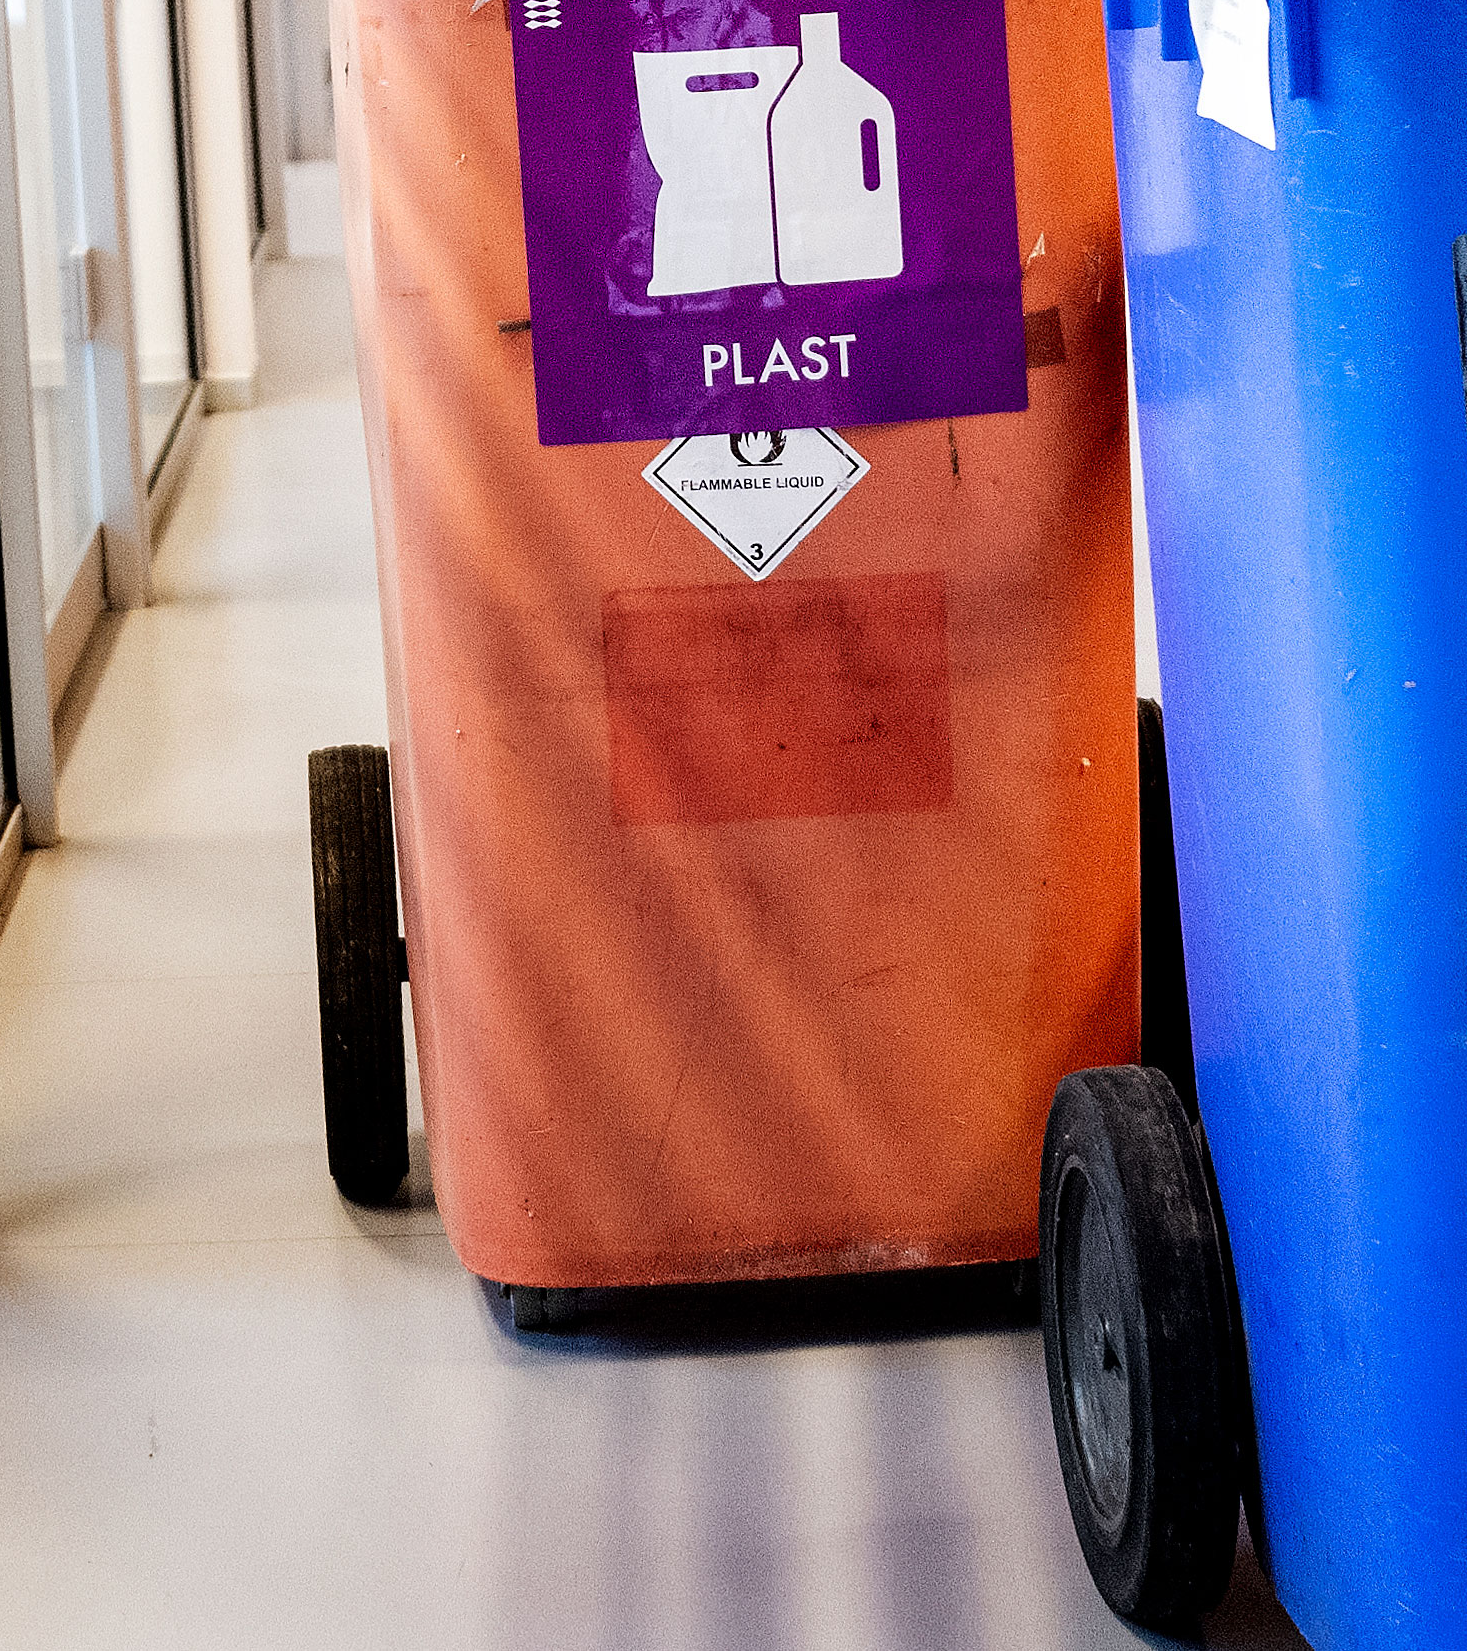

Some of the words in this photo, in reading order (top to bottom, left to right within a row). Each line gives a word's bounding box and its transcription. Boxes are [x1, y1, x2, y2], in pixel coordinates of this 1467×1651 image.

[703, 334, 857, 387] PLAST
[681, 477, 772, 492] FLAMMABLE
[776, 476, 825, 490] LIQUID
[749, 543, 764, 561] 3
